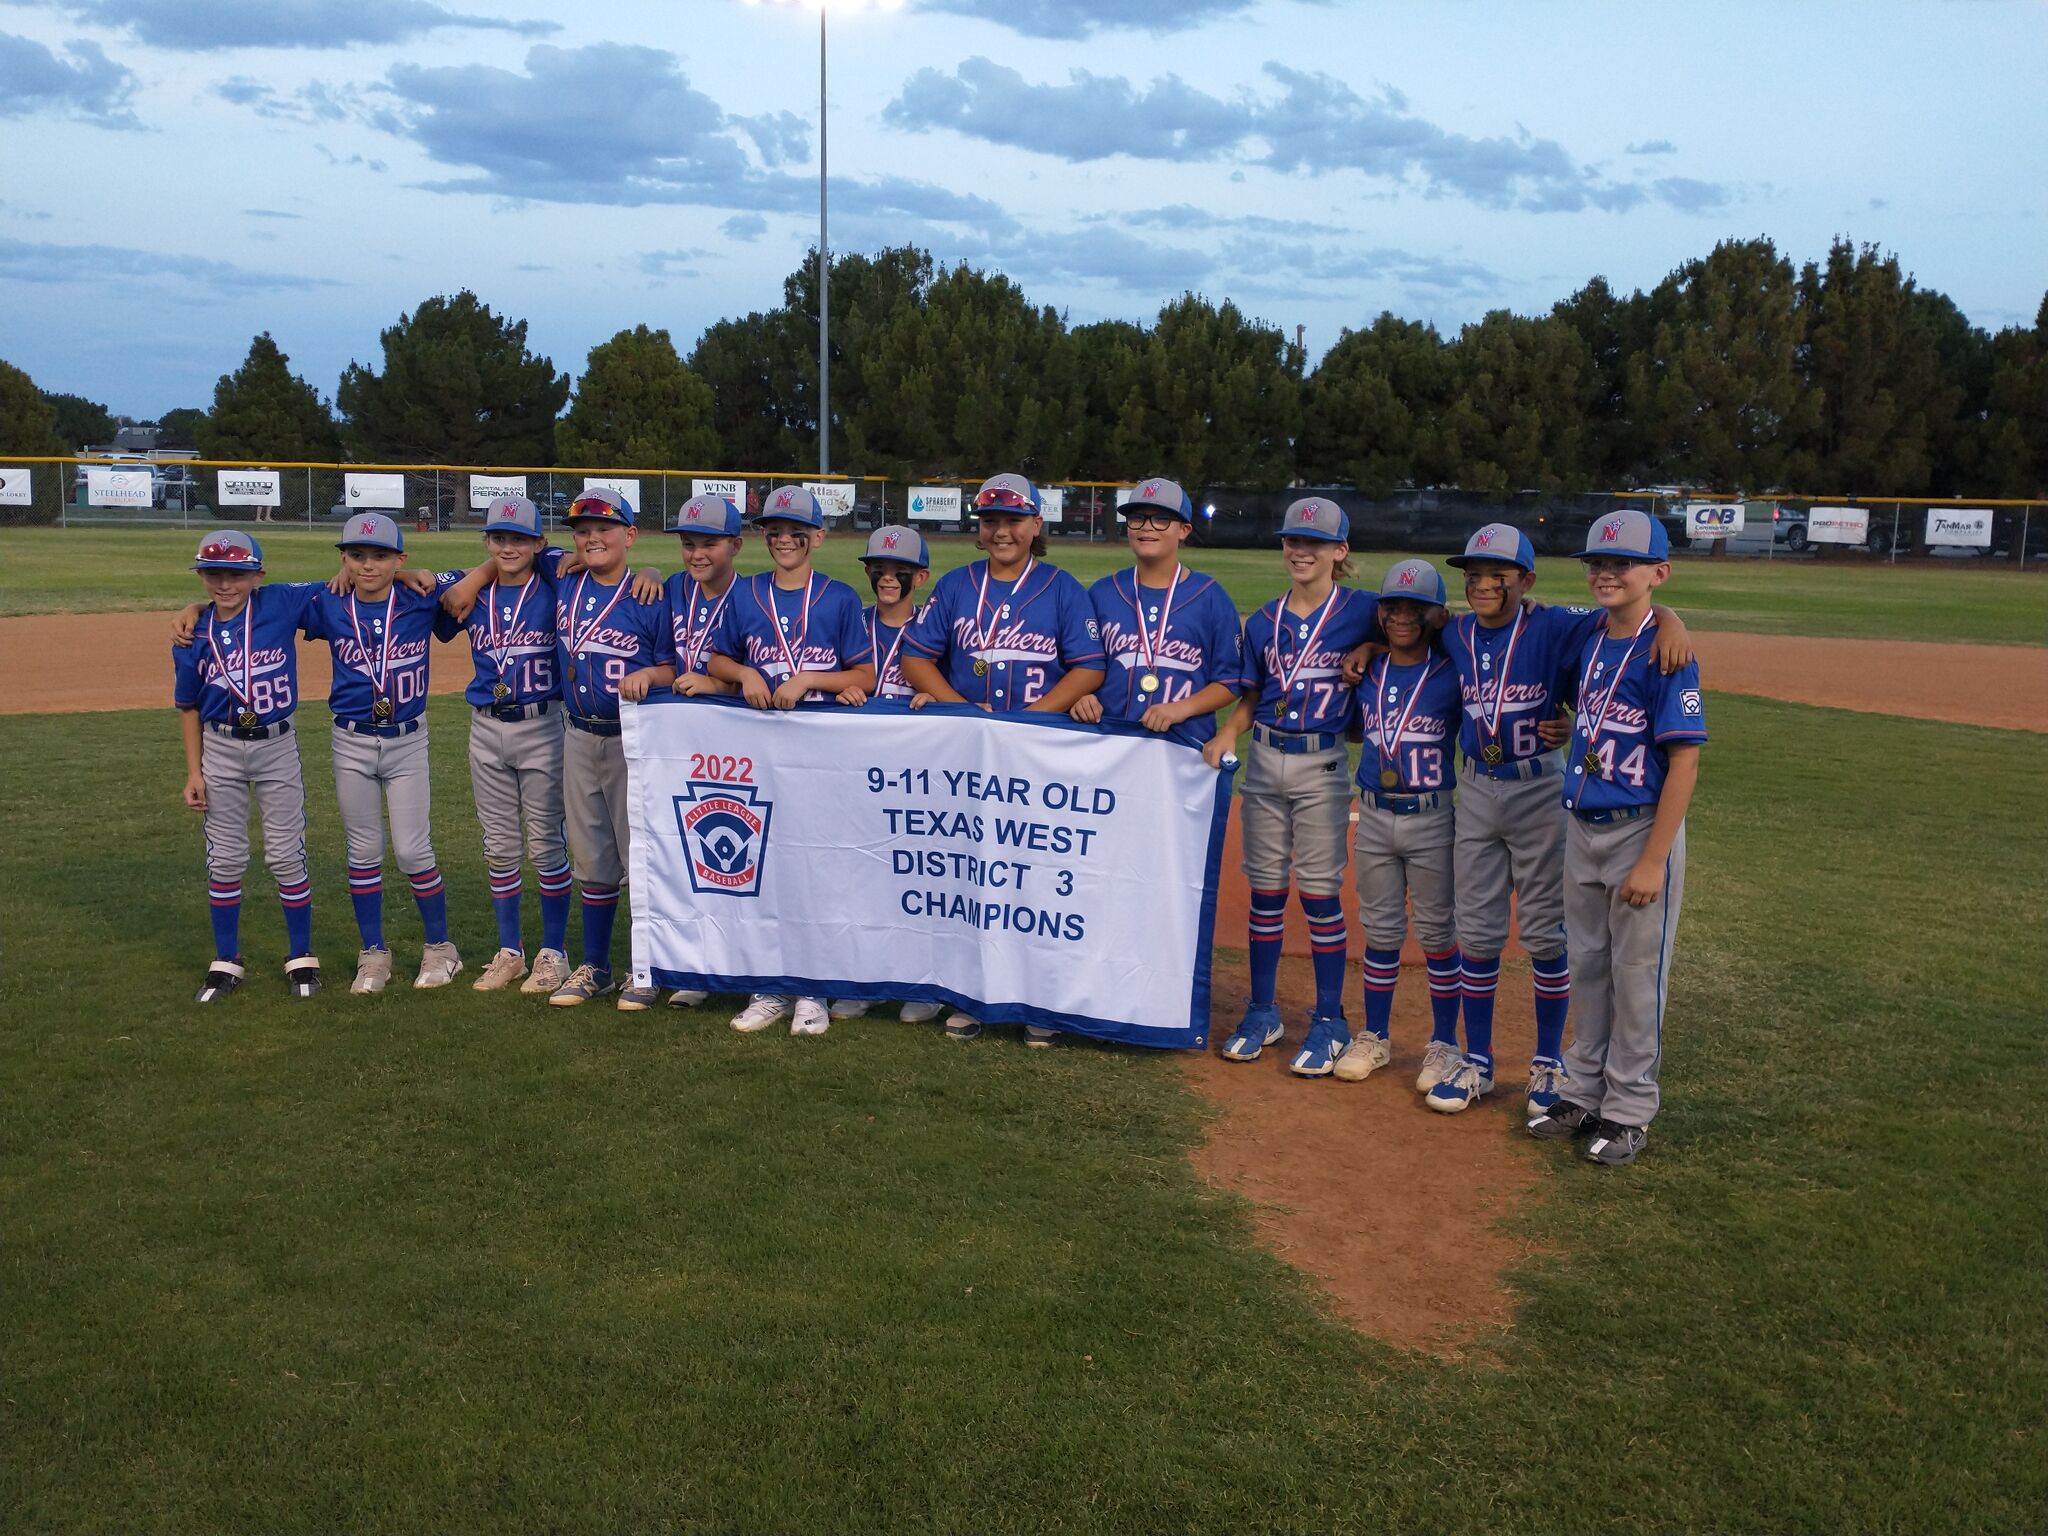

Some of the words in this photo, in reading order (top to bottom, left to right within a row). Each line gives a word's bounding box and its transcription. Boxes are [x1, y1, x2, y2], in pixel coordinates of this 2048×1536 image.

[94, 489, 146, 498] STEELHEAD
[704, 483, 736, 492] WTNB
[251, 673, 292, 715] 85
[397, 665, 426, 703] 00
[522, 659, 553, 693] 15
[605, 659, 625, 693] 9
[1023, 666, 1045, 703] 2
[1513, 717, 1537, 757] 6
[690, 753, 754, 784] 2022
[1409, 747, 1443, 787] 13
[1597, 738, 1647, 787] 44
[867, 766, 930, 795] 9-11
[942, 769, 1032, 806] YEAR
[1042, 782, 1116, 816] OLD
[687, 801, 720, 823] LITTLE
[722, 802, 758, 828] LEAGUE
[882, 808, 985, 844] TEXAS
[995, 817, 1097, 857] WEST
[702, 869, 750, 886] BASEBALL
[892, 849, 1032, 890] DISTRICT
[1055, 869, 1074, 897] 3
[901, 889, 1085, 942] CHAMPIONS
